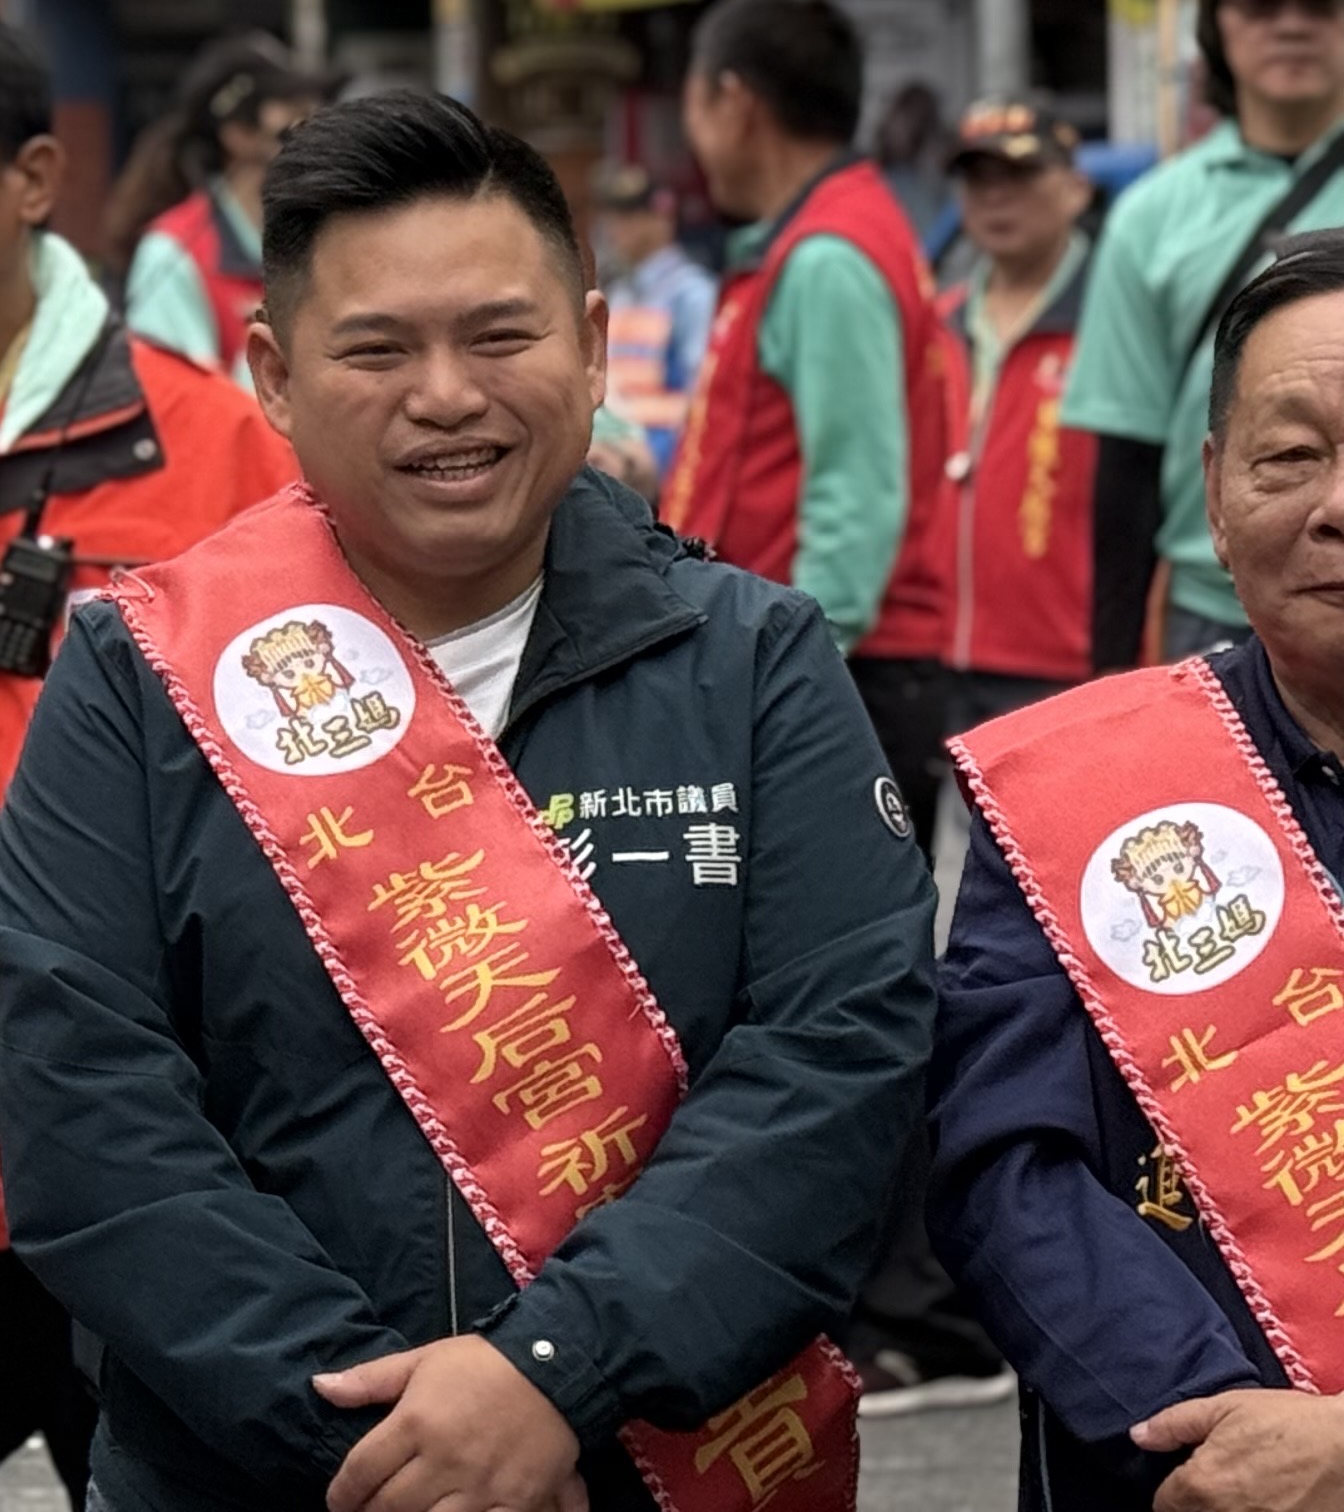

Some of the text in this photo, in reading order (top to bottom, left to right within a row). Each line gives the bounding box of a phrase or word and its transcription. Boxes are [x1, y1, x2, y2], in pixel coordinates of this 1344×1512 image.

[276, 693, 402, 766] 北三媽
[579, 782, 740, 819] 新北市議員
[1142, 893, 1266, 983] 北三媽
